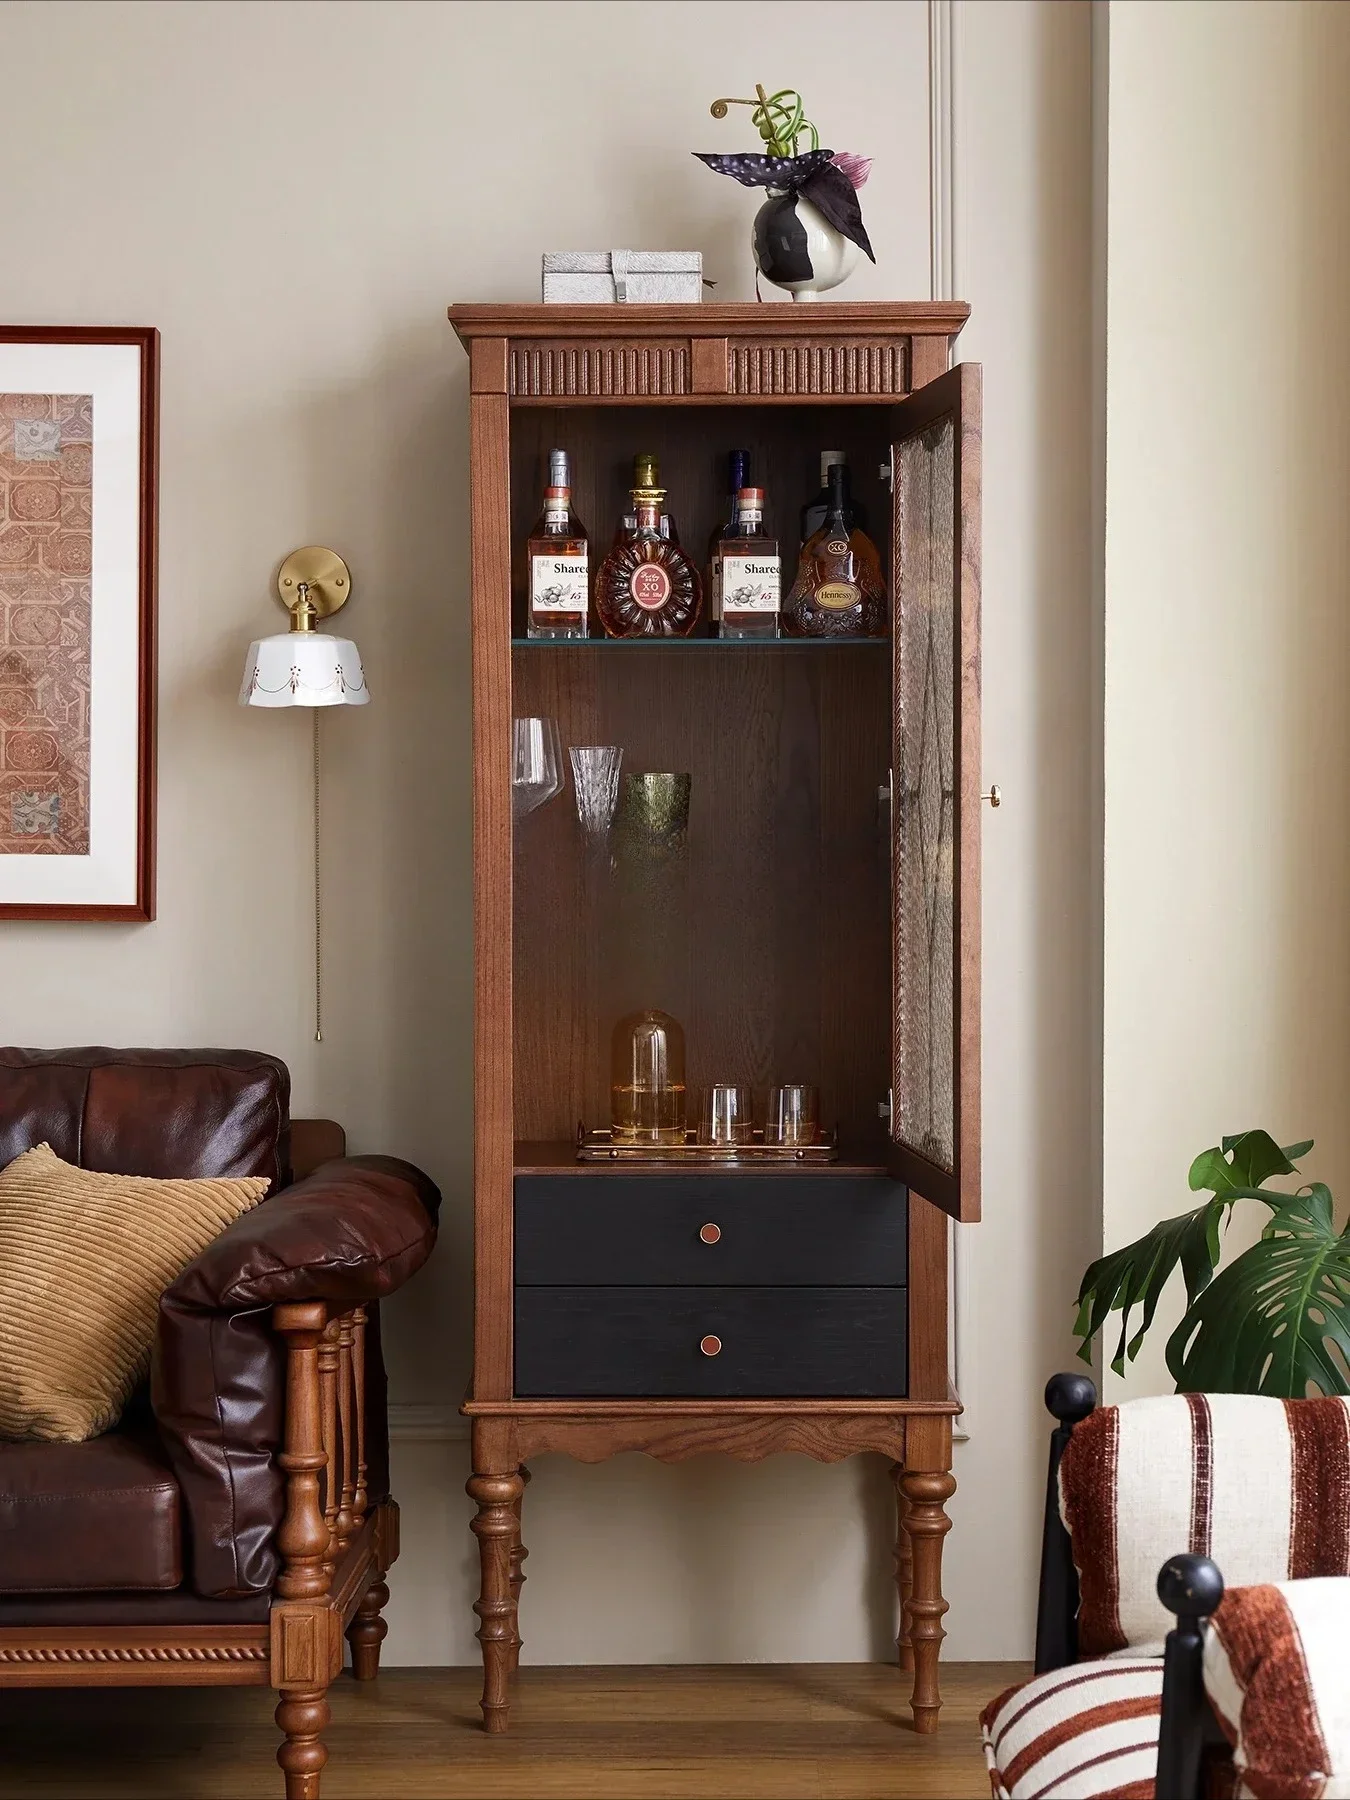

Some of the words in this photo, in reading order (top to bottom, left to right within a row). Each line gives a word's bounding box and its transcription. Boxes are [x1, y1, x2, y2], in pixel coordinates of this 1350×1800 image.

[831, 543, 846, 551] XO
[642, 582, 659, 591] XO
[760, 592, 772, 600] 15
[821, 591, 852, 600] Hennessy
